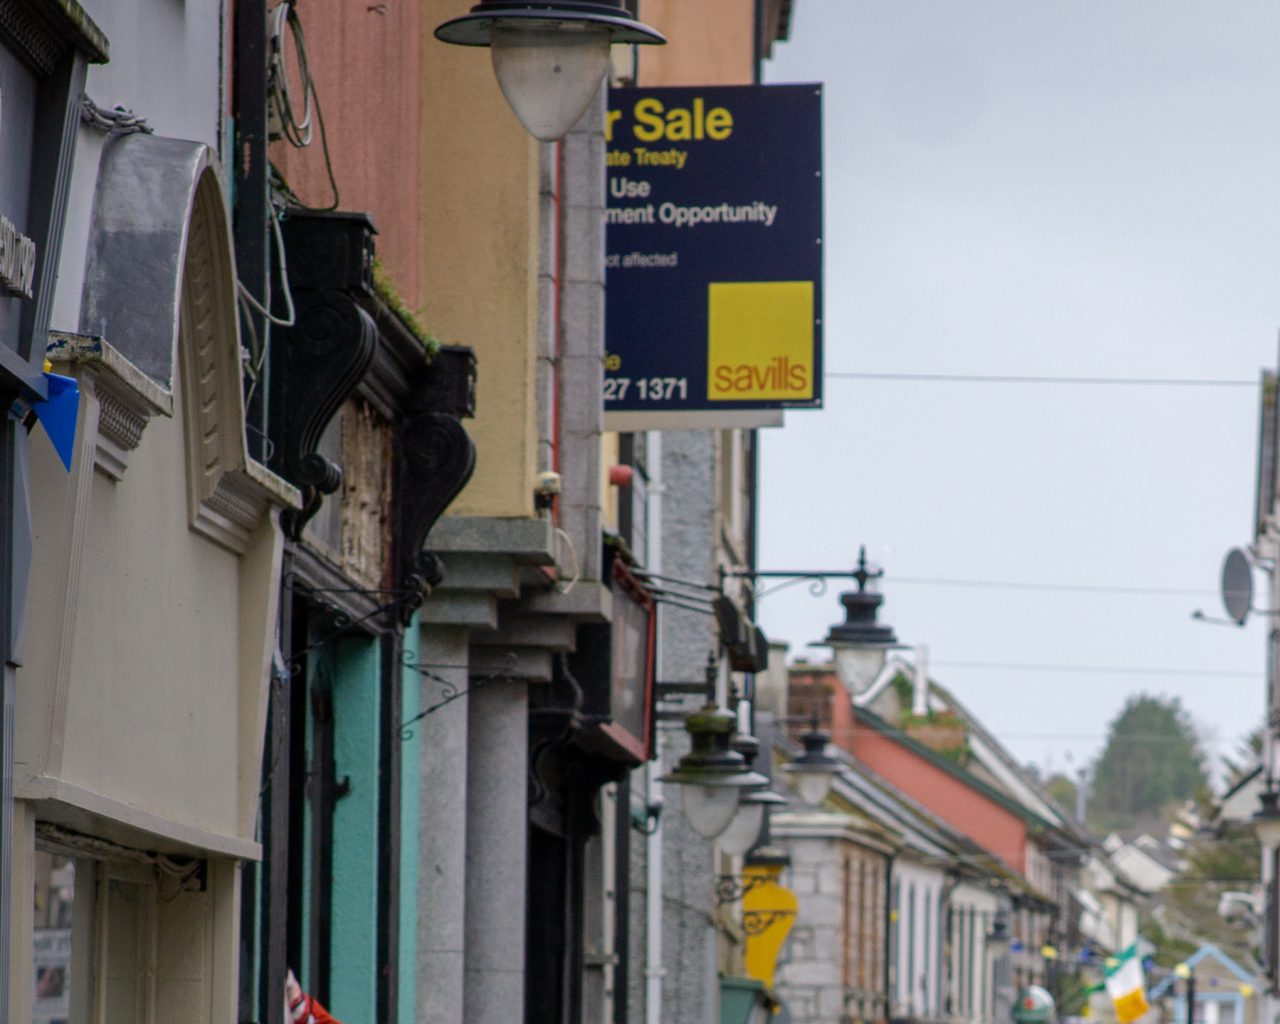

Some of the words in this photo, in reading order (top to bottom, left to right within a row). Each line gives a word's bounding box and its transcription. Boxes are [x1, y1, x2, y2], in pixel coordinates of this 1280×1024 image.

[633, 98, 734, 142] Sale
[605, 151, 631, 166] ate
[633, 148, 687, 168] Treaty
[611, 177, 651, 198] Use
[603, 205, 654, 224] ment
[659, 202, 777, 227] Opportunity
[622, 251, 678, 268] affected
[714, 356, 808, 392] savills
[603, 379, 631, 400] 27
[636, 378, 687, 400] 1371
